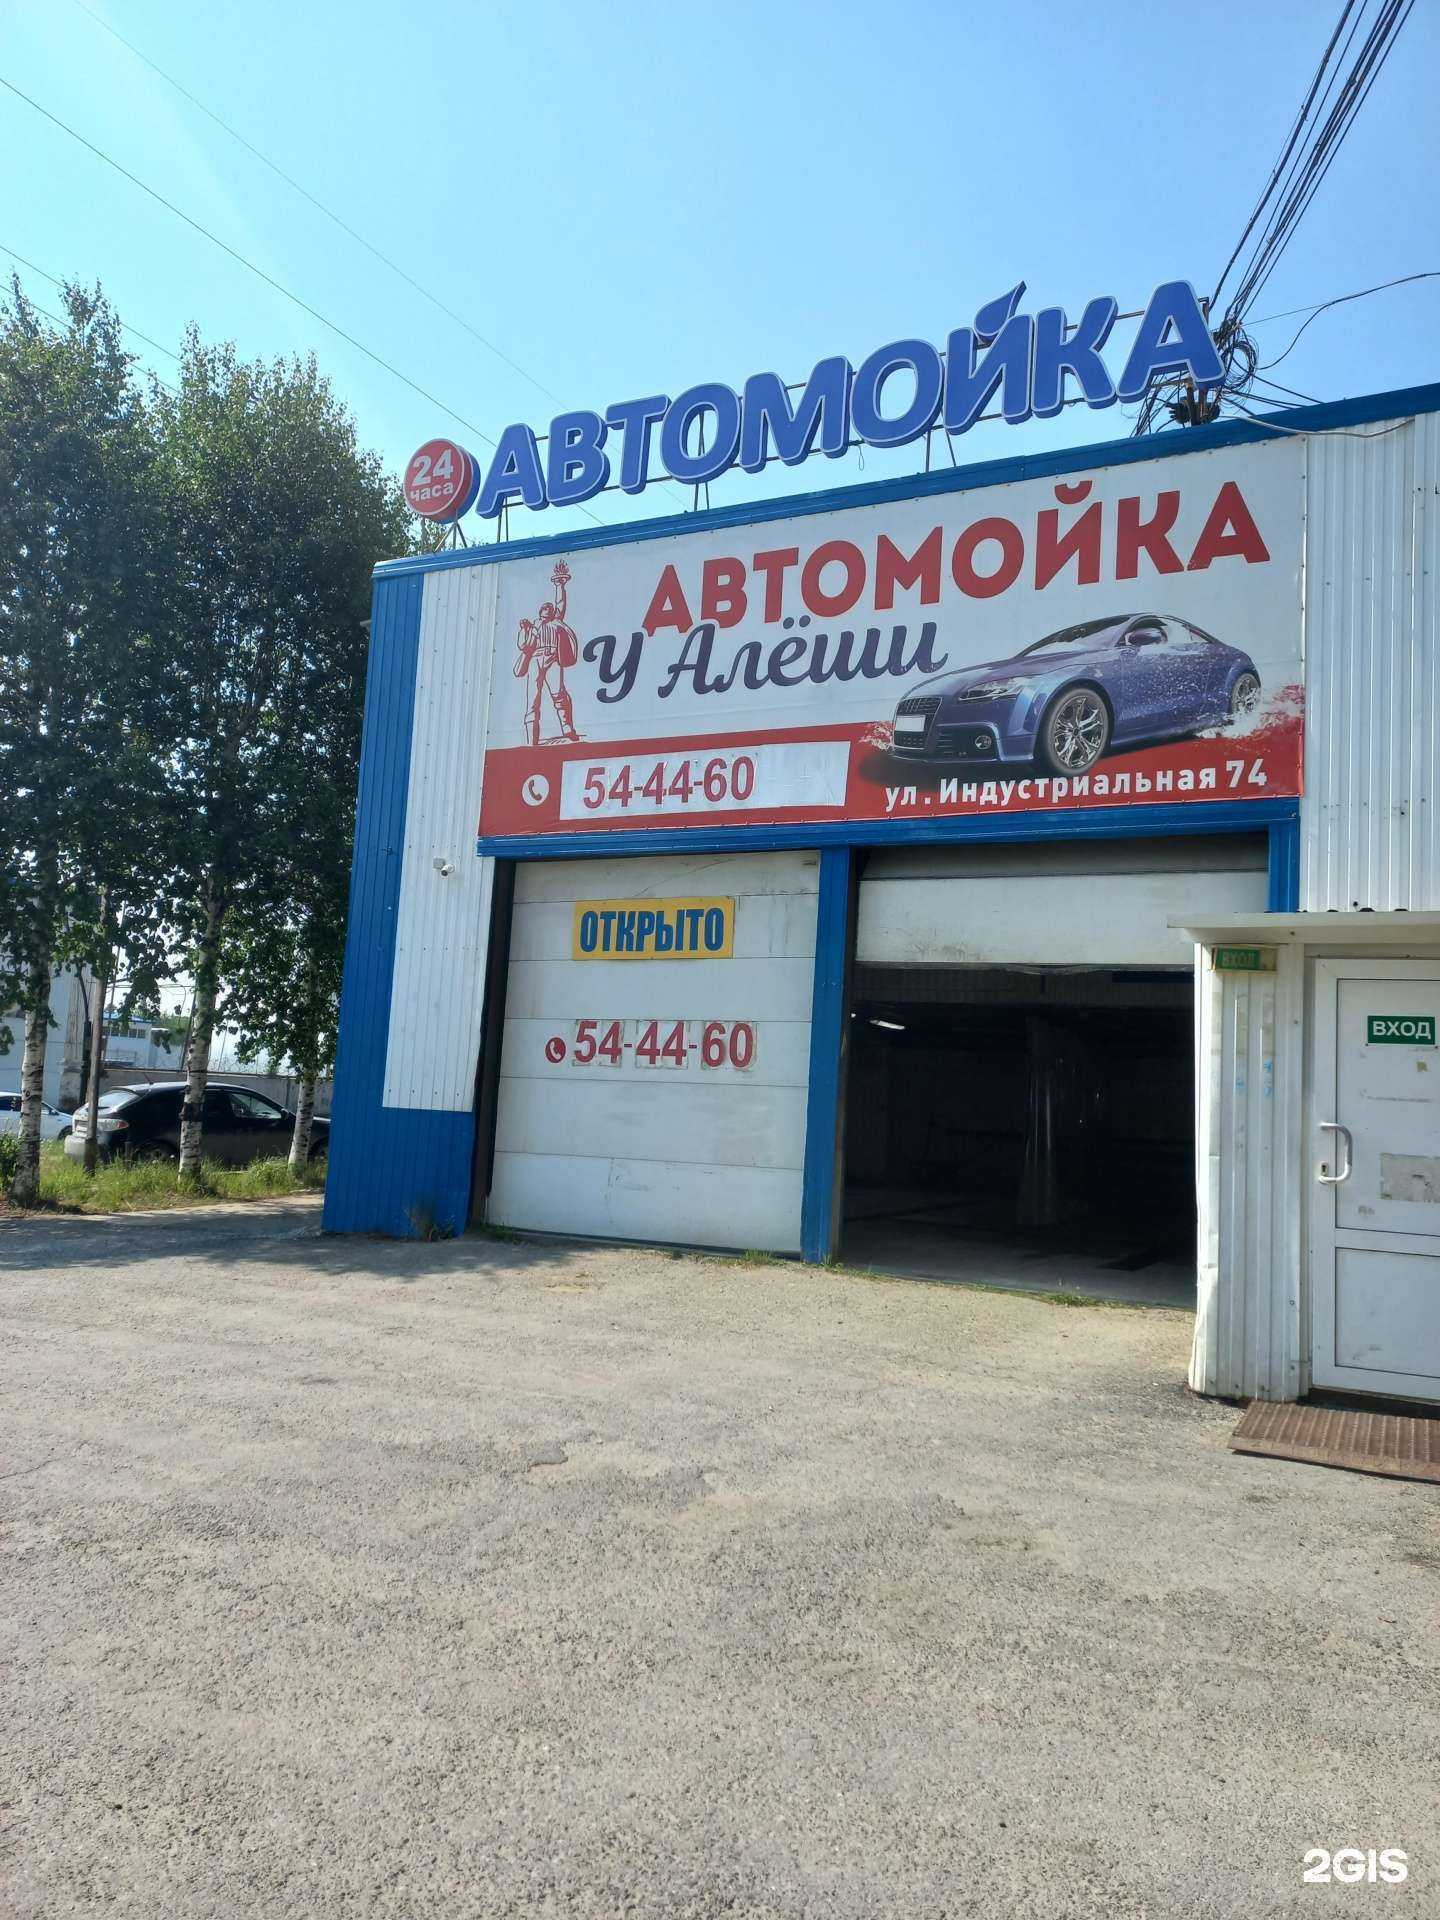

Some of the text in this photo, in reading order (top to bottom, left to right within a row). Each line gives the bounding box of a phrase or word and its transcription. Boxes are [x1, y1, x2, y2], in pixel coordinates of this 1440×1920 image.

[475, 279, 1226, 520] АВТОМОЙКА
[410, 481, 454, 502] часа
[411, 448, 454, 487] 24
[642, 480, 1271, 636] АВТОМОЙКА
[657, 615, 949, 699] Алёши
[582, 755, 755, 809] 54-44-60
[884, 758, 1269, 811] ул. Индустриальная 74
[579, 907, 725, 953] ОТКРЫТО
[574, 1019, 754, 1069] 54-44-60
[1372, 1020, 1432, 1040] ВХОД
